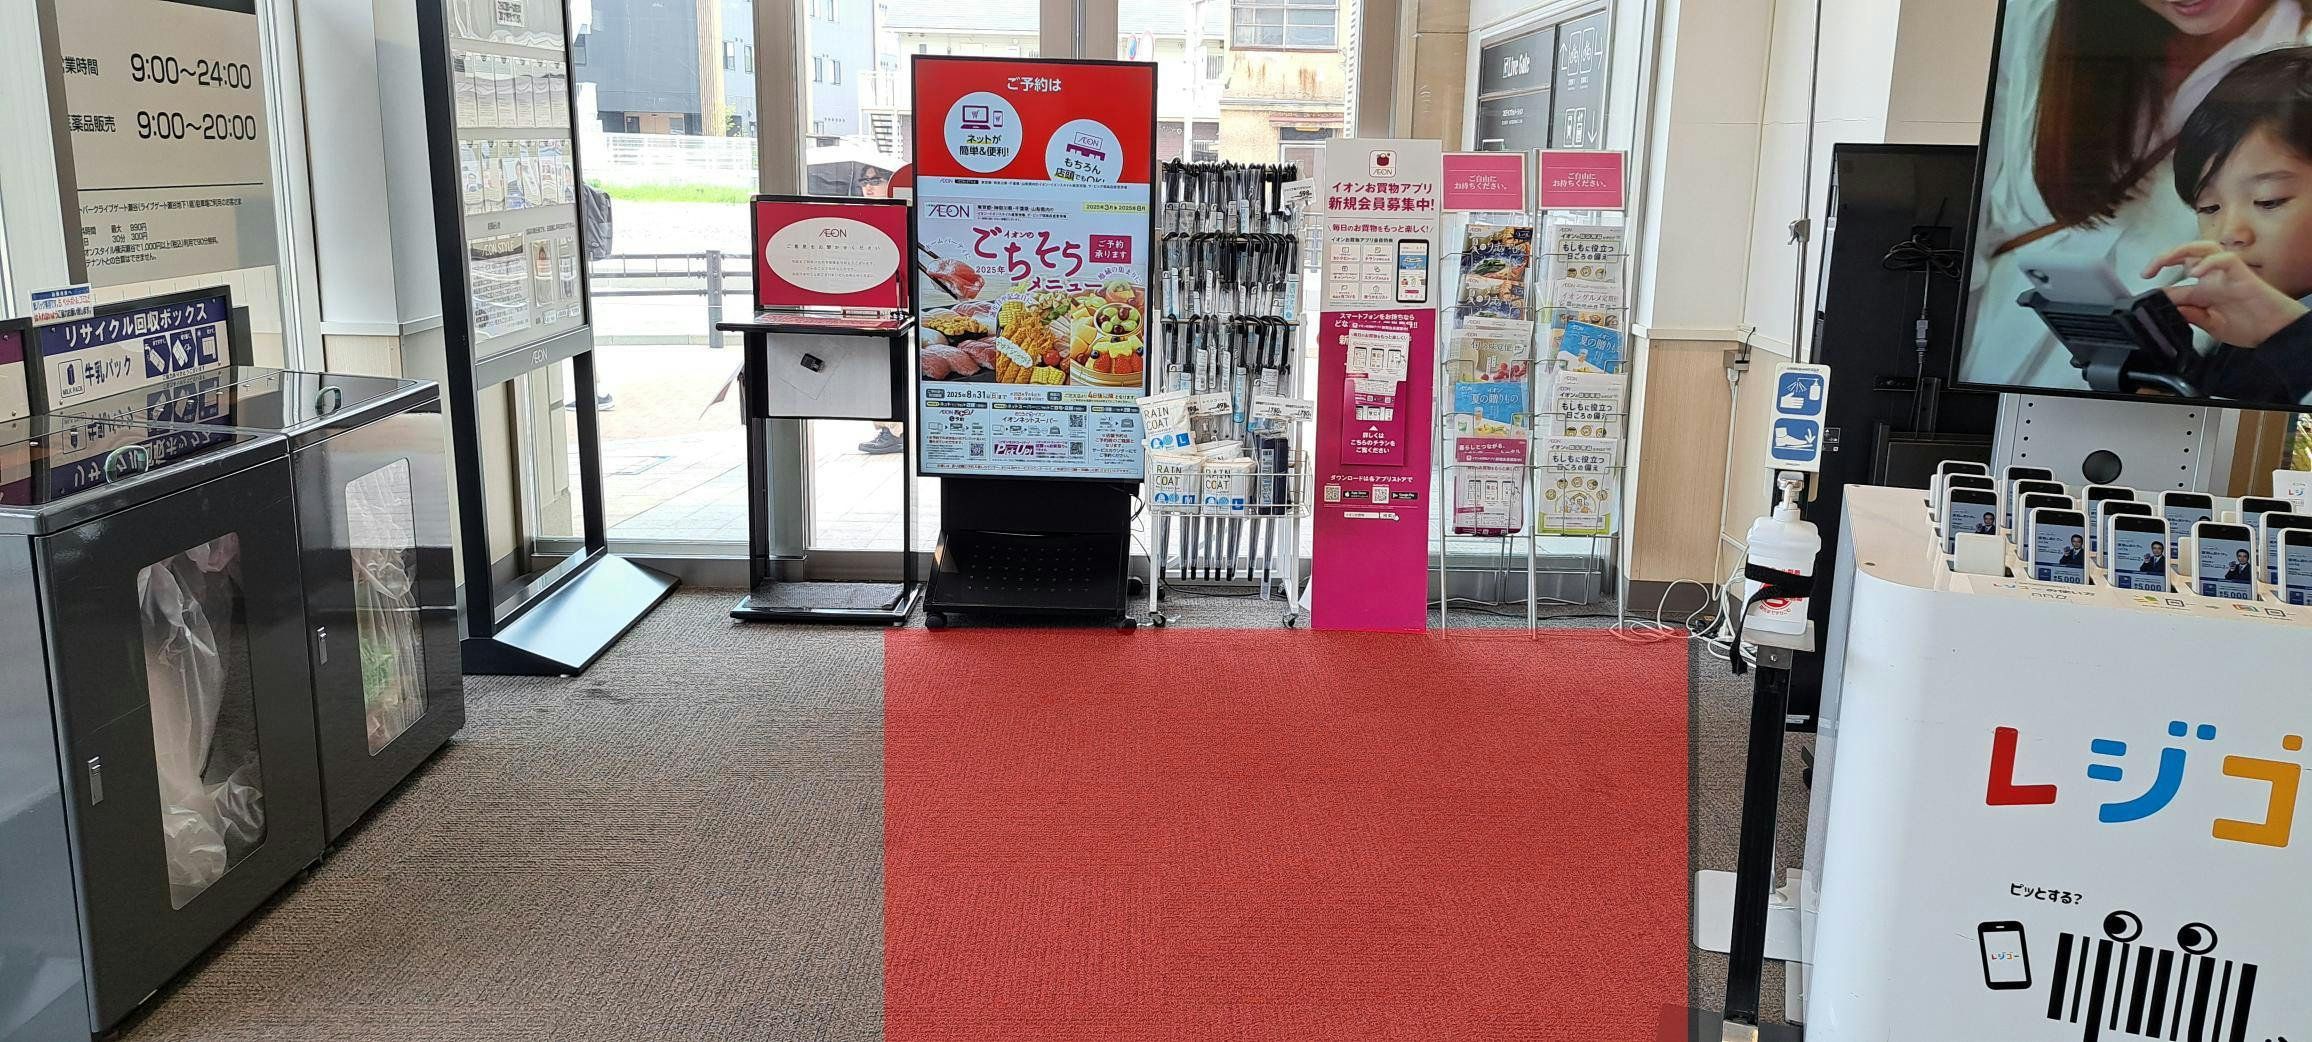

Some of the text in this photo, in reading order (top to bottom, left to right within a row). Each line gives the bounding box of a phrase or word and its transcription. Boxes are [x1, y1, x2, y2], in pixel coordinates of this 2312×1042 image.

[62, 56, 99, 76] 業時間
[1007, 76, 1062, 92] ご予約は
[966, 134, 1002, 145] ネットが
[959, 145, 1010, 157] 簡単&便利!
[1064, 157, 1102, 175] もちろん
[1468, 175, 1497, 183] ご自由に
[1567, 172, 1597, 181] ご自由に
[1332, 182, 1433, 194] イオンお買物アプリ
[1454, 182, 1508, 190] お持ちください。
[1552, 180, 1607, 188] お持ちください。
[1328, 197, 1435, 212] 新規会員募集中!
[1332, 223, 1429, 234] 毎日のお買物をもっと楽しく!
[1097, 239, 1125, 249] ご予約
[1562, 241, 1614, 253] もしもに役立つ
[1094, 249, 1128, 259] 承ります
[976, 265, 1006, 275] 2025年
[1027, 277, 1103, 293] メニュー
[1339, 312, 1415, 321] スマートフォンをお持ちなら
[64, 302, 208, 349] リサイクル回収ボックス
[85, 355, 132, 388] 牛乳パック
[1561, 401, 1613, 412] もしもに役立つ
[1143, 406, 1169, 419] RAIN
[1146, 418, 1169, 431] COAT
[1552, 452, 1605, 464] もしもに役立つ
[1156, 464, 1182, 474] RAIN
[1205, 468, 1231, 479] RAIN
[1155, 475, 1180, 486] COAT
[1329, 474, 1414, 483] ダウンロードは各アプリストアで
[1205, 480, 1230, 491] COAT
[2009, 882, 2083, 906] ピッとする?
[1991, 951, 2020, 961] レジゴー
